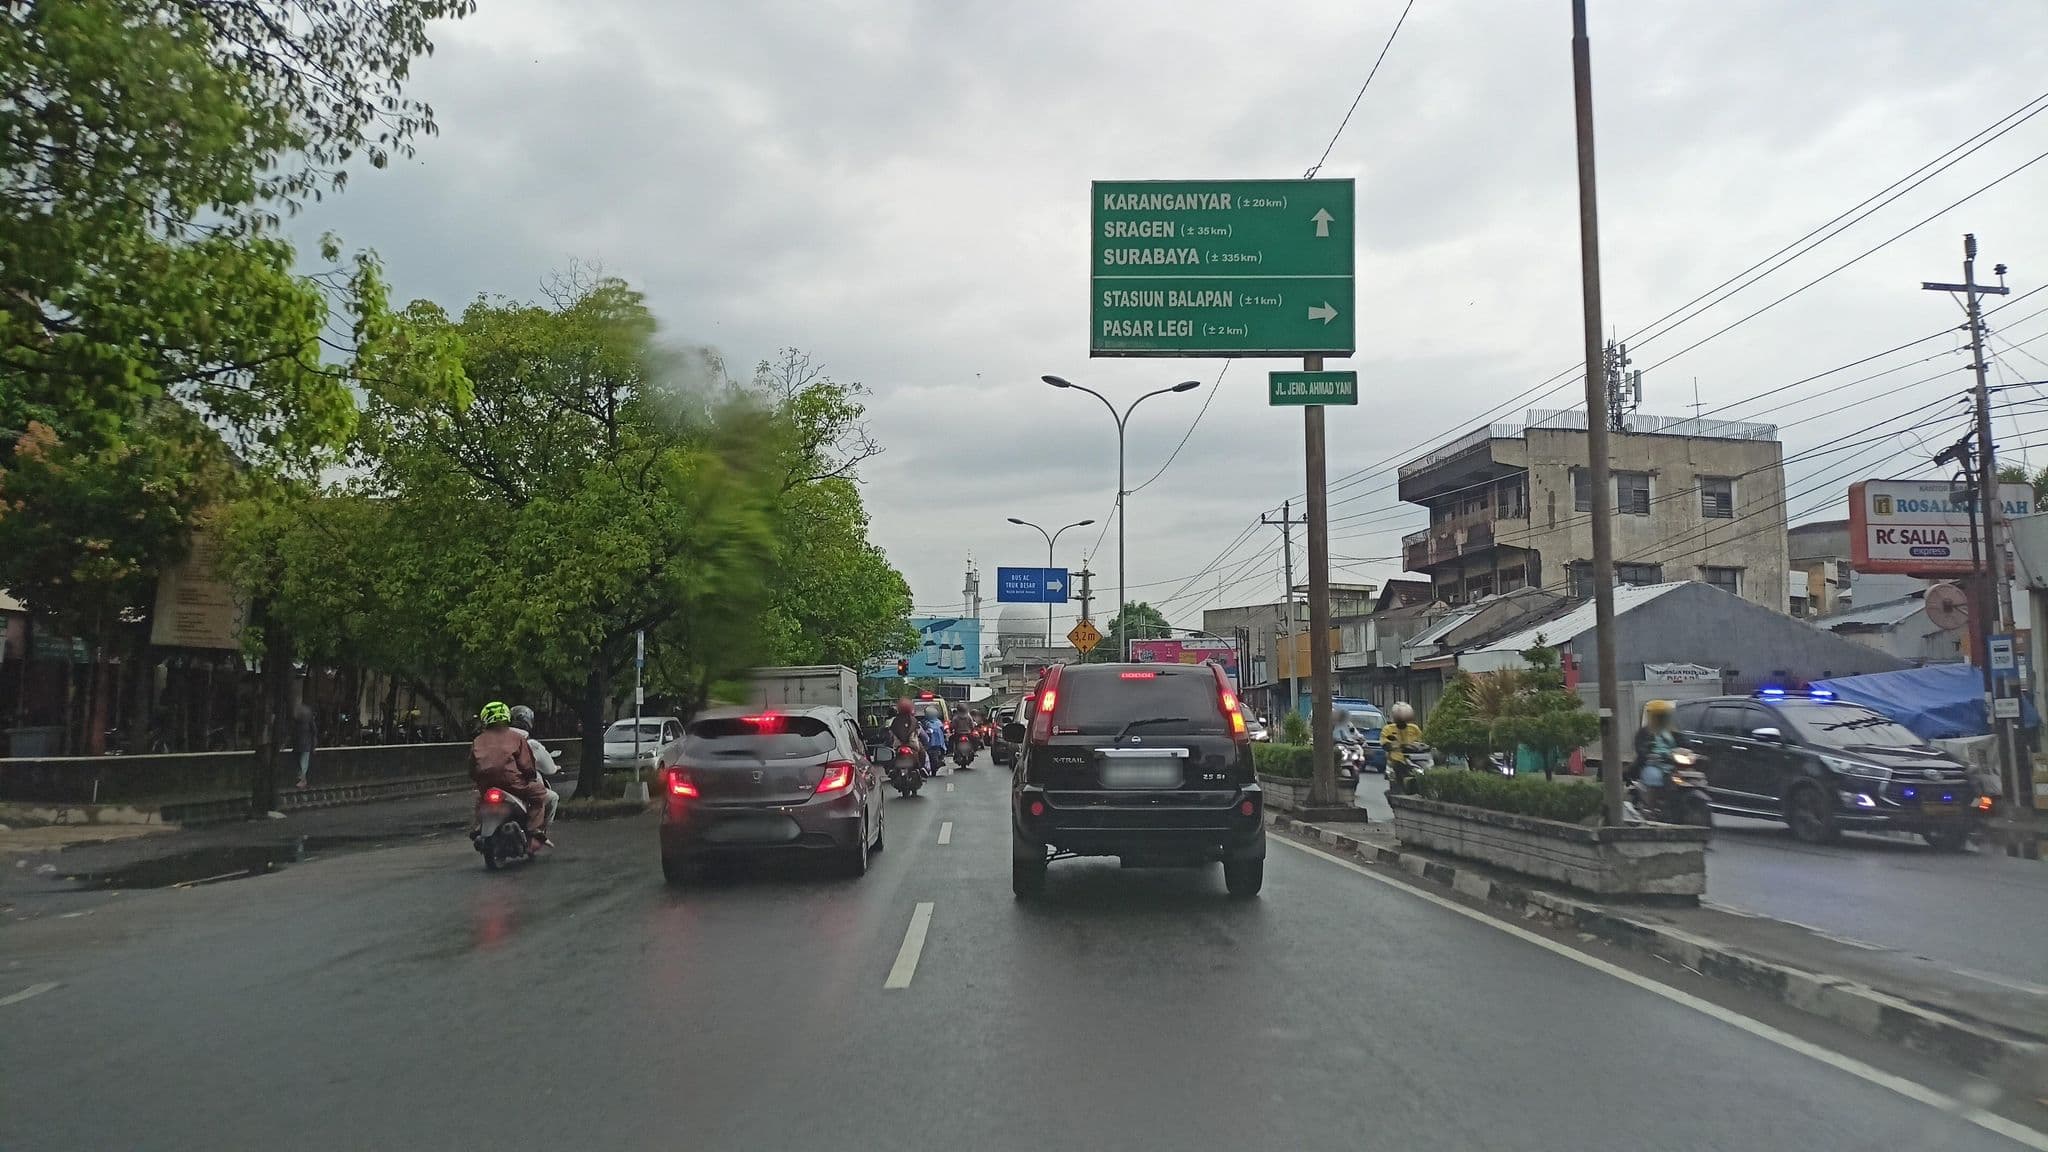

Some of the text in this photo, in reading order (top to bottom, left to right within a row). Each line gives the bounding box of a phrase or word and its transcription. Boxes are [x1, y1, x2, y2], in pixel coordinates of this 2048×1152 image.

[1103, 193, 1232, 211] KARANGANYAR
[1104, 221, 1175, 238] SRAGEN
[1103, 248, 1200, 265] SURABAYA
[1103, 290, 1164, 308] STASIUN
[1168, 290, 1233, 308] BALAPAN
[1103, 320, 1154, 337] PASAR
[1158, 320, 1193, 337] LEGI
[1275, 381, 1352, 396] JL. JEND. AHMAD YANI
[1876, 528, 1950, 545] ROSALIA
